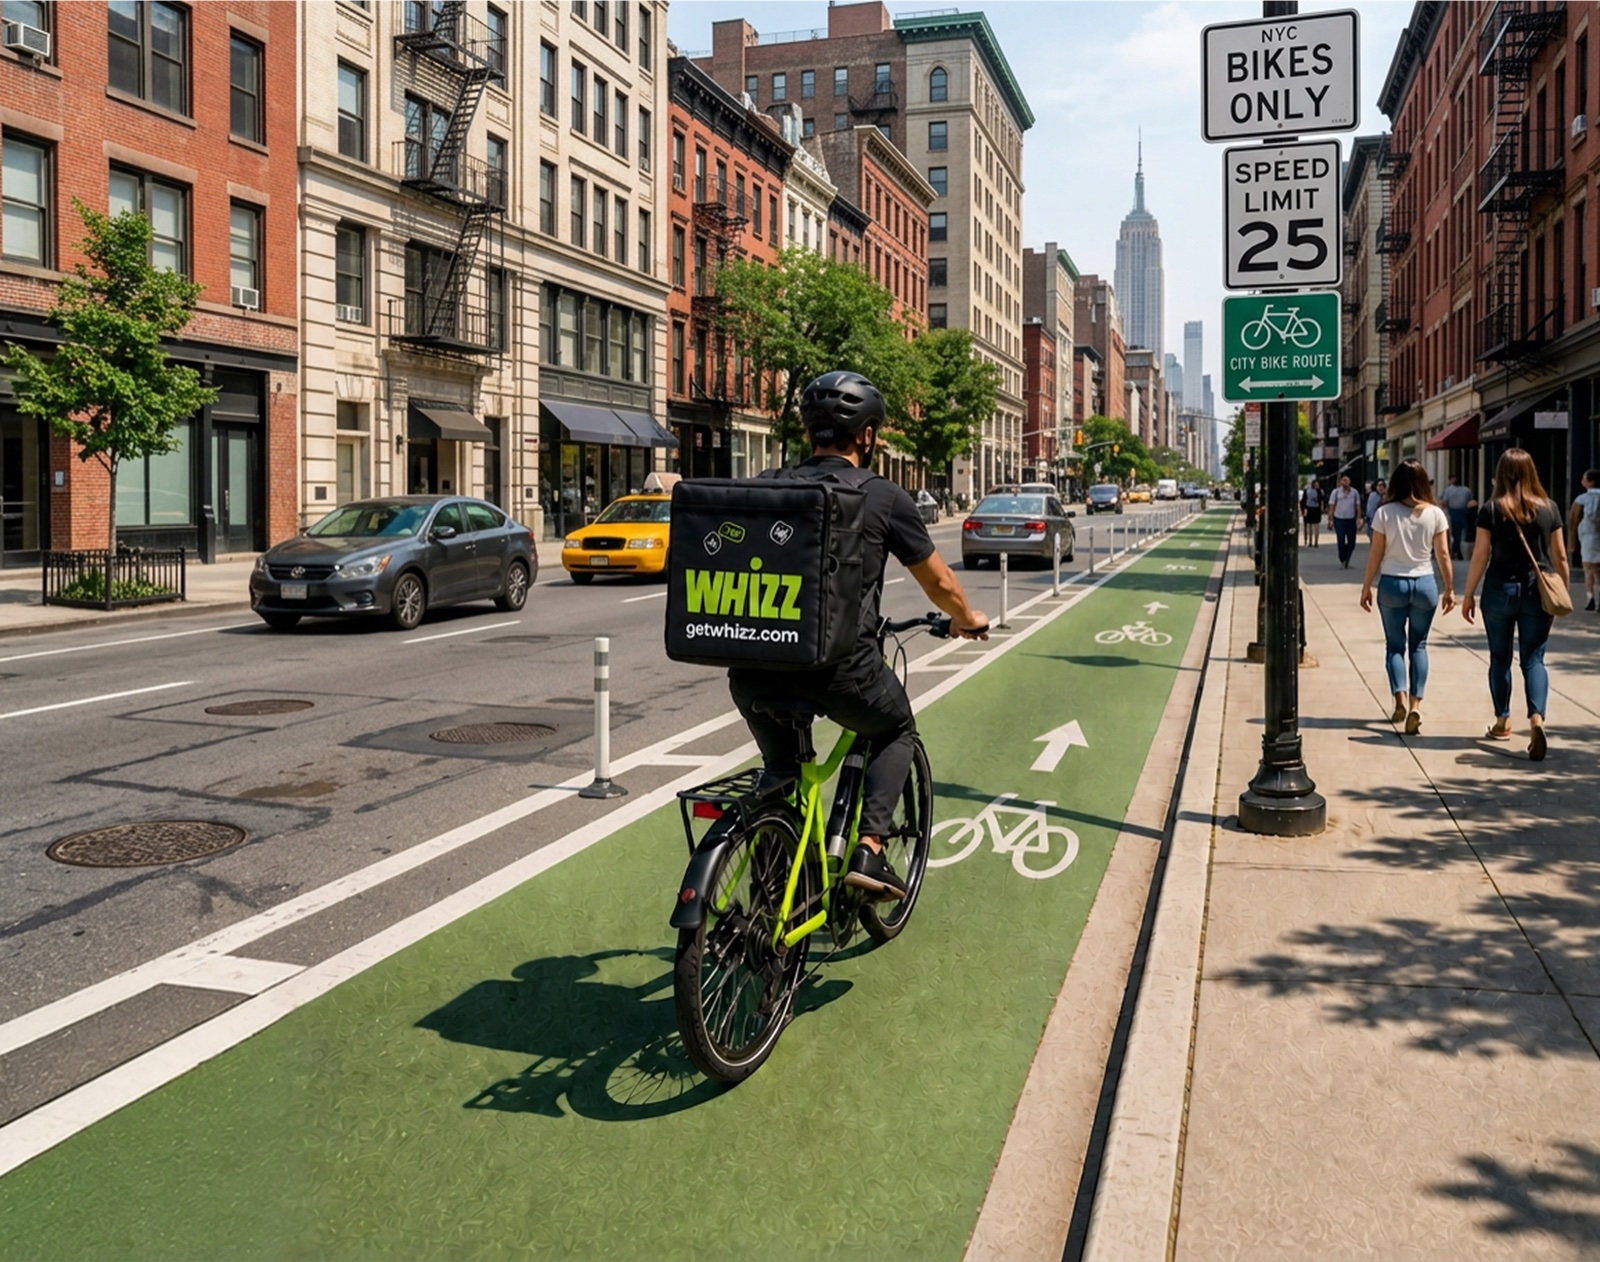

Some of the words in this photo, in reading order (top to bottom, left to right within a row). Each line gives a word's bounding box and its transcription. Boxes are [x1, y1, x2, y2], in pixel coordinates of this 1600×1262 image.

[1261, 25, 1298, 43] NYC
[1227, 43, 1333, 83] BIKES
[1230, 85, 1330, 124] ONLY
[1235, 158, 1329, 184] SPEED
[1245, 188, 1319, 213] LIMIT
[1237, 218, 1328, 273] 25
[1230, 357, 1256, 371] CITY
[1261, 355, 1288, 370] BIKE
[1293, 354, 1332, 368] ROUTE
[686, 622, 799, 643] getwhizz.com
